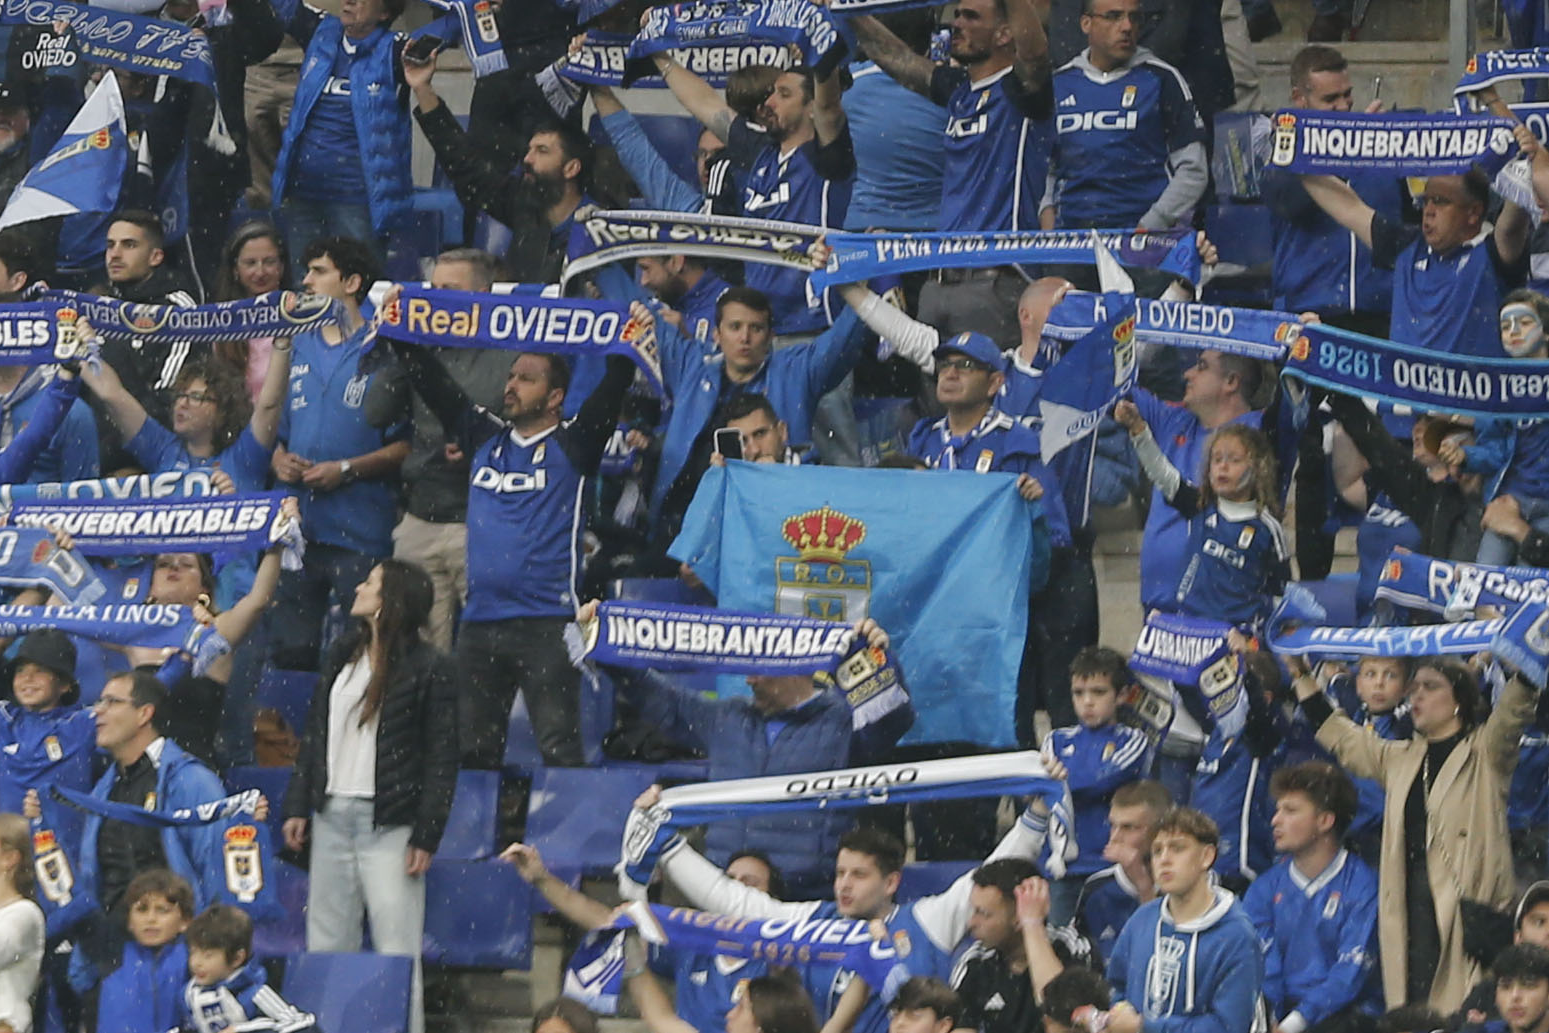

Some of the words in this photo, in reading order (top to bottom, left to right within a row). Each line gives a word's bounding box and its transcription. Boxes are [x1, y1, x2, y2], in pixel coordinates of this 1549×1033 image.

[22, 46, 77, 69] OVIEDO
[1057, 110, 1137, 133] DIGI
[586, 220, 659, 247] Real
[877, 234, 931, 263] PEÑA
[169, 309, 232, 328] OVIEDO
[408, 298, 479, 337] Real
[489, 305, 620, 344] OVIEDO
[1150, 300, 1235, 336] OVIEDO
[1319, 341, 1383, 382] 1926
[1394, 359, 1492, 401] OVIEDO
[472, 465, 546, 495] DIGI
[1203, 539, 1246, 567] DIGI
[607, 614, 852, 657] INQUEBRANTABLES
[787, 767, 918, 797] OVIEDO
